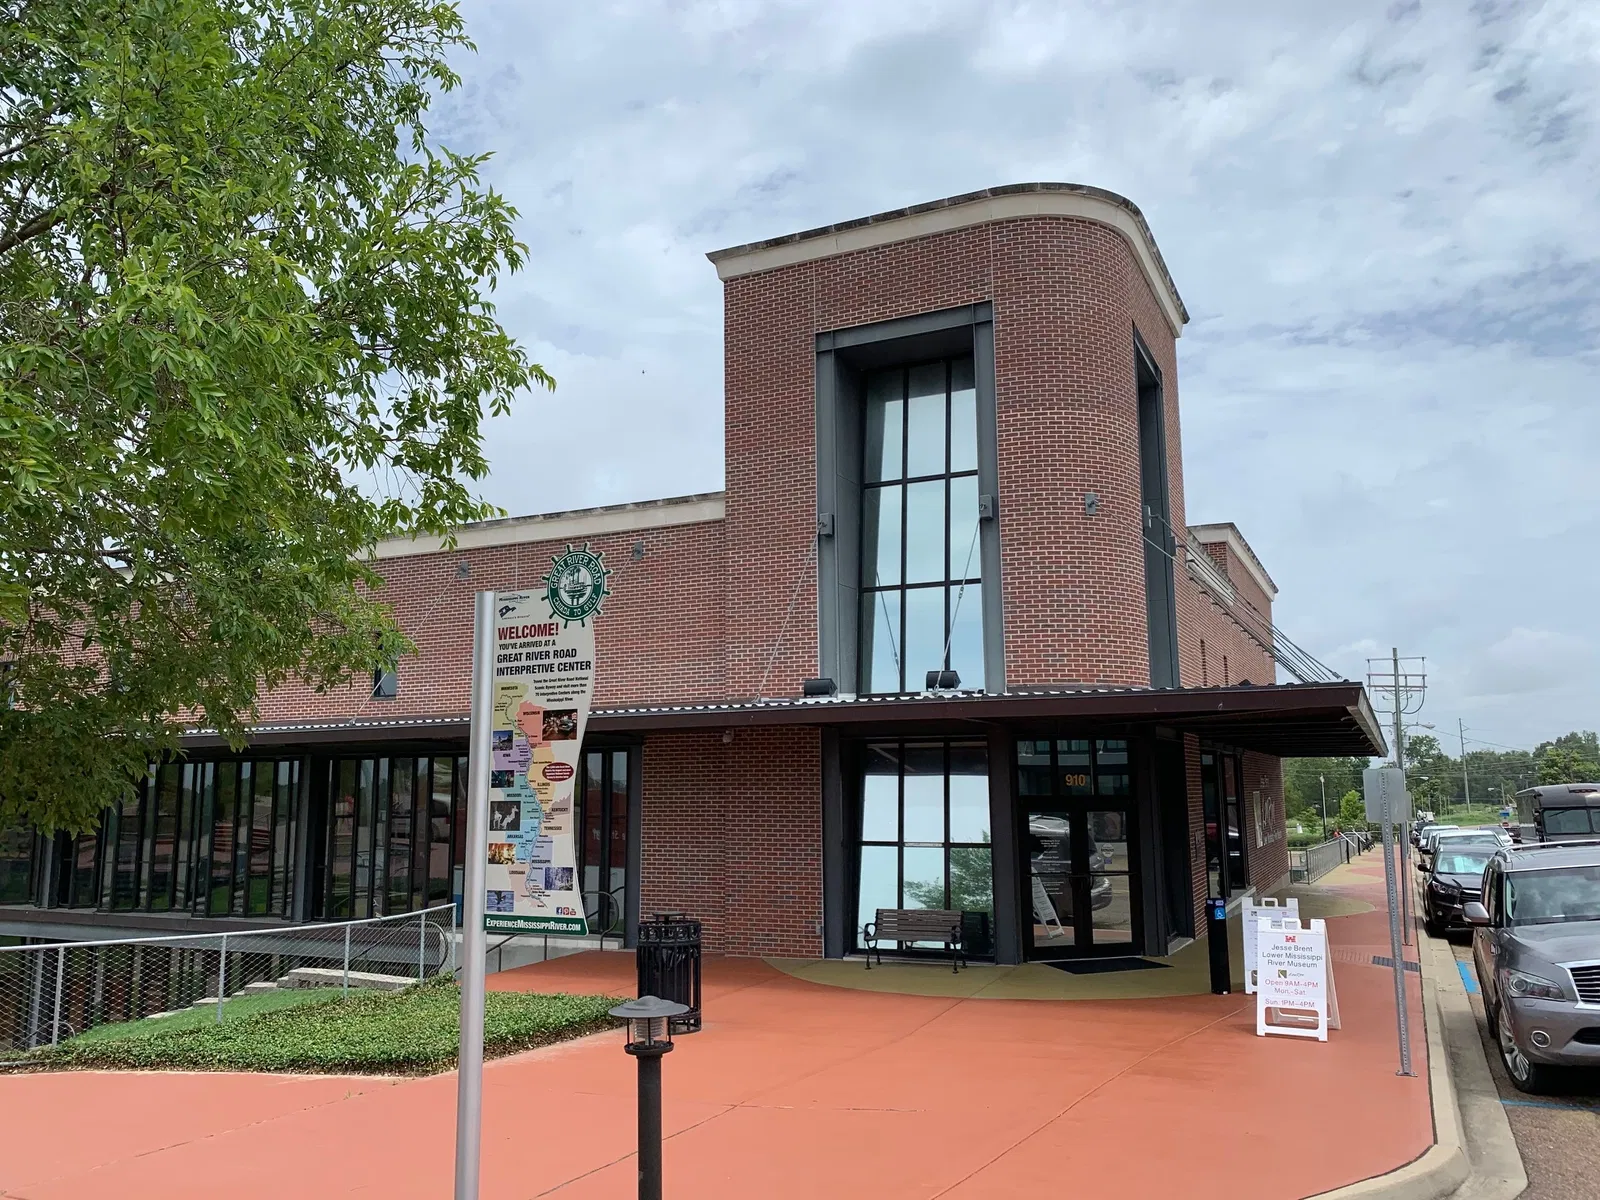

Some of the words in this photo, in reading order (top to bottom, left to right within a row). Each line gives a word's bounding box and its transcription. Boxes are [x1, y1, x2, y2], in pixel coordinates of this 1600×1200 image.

[551, 562, 566, 588] GREAT
[567, 555, 589, 565] RIVER
[588, 562, 601, 584] ROAD
[553, 597, 570, 615] CANADA
[584, 593, 597, 611] GULF
[498, 622, 559, 640] WELCOME!
[499, 642, 517, 650] YOU'VE
[519, 640, 542, 649] ARRIVED
[497, 653, 523, 663] GREAT
[525, 650, 550, 661] RIVER
[553, 648, 577, 659] ROAD
[496, 663, 555, 676] INTERPRETIVE
[557, 661, 591, 672] CENTER
[1066, 774, 1086, 786] 910
[1285, 953, 1323, 961] Mississippi
[1265, 979, 1283, 987] Open
